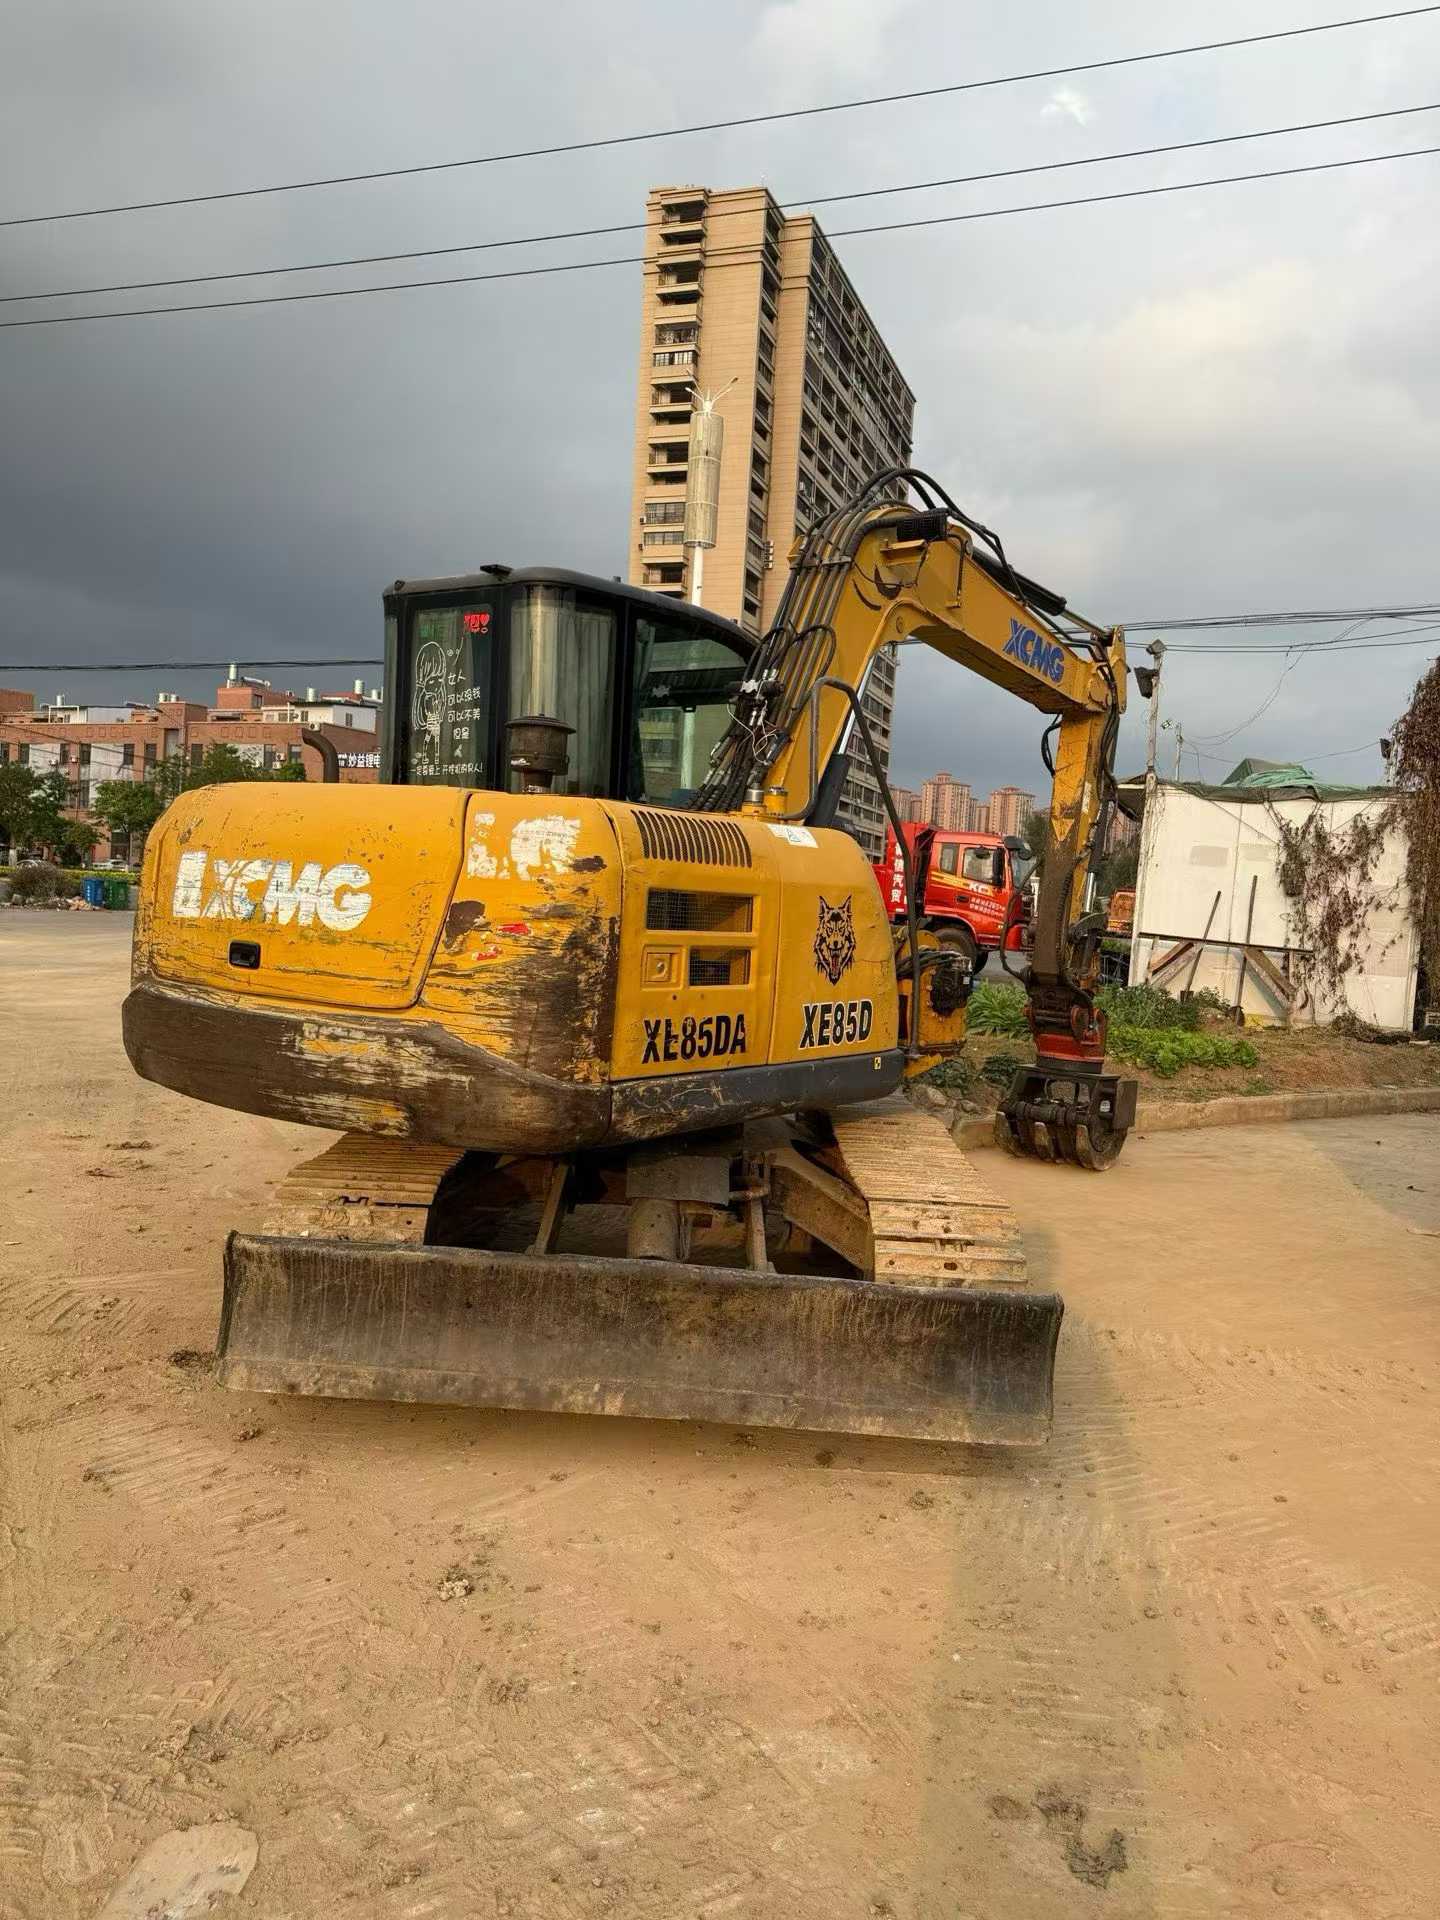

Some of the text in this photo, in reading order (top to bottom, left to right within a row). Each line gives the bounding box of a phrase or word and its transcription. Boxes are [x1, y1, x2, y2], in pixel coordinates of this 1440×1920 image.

[1003, 618, 1065, 682] XCMG
[447, 669, 466, 685] 女人
[799, 999, 873, 1050] XE85D
